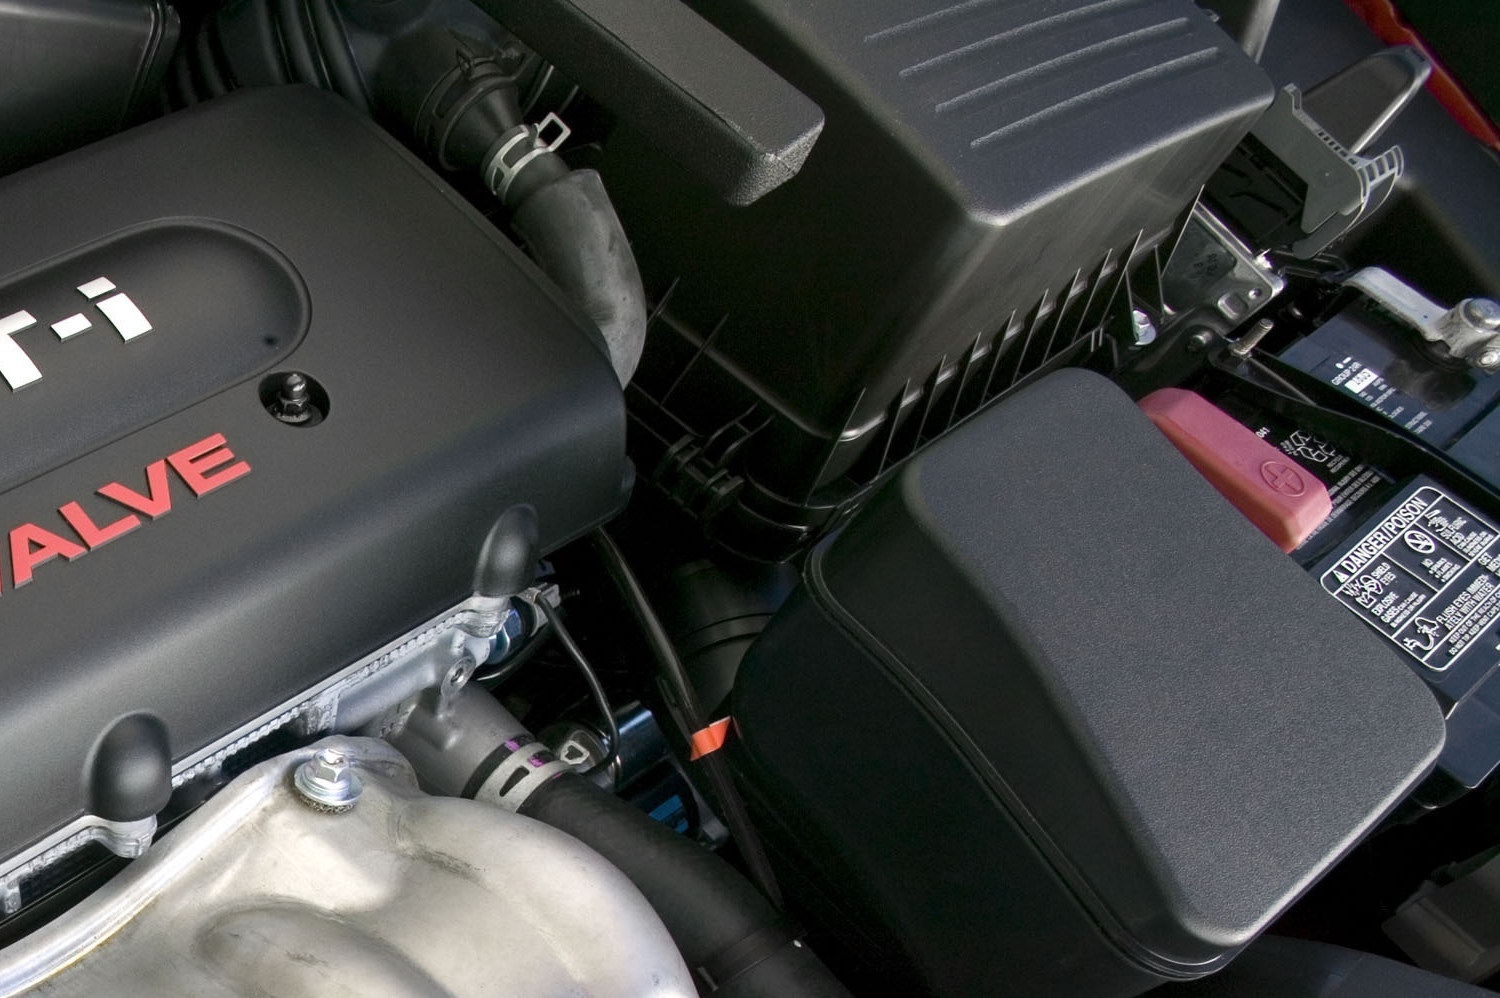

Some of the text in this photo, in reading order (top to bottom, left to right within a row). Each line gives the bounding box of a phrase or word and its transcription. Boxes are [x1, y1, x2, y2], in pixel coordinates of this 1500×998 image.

[1340, 495, 1429, 573] DANGER/POISON
[1370, 561, 1392, 579] SHIELD
[1379, 570, 1397, 586] EYES
[1434, 603, 1459, 625] FLUSH
[1451, 590, 1472, 608] EYES
[1442, 610, 1465, 631] ATELY
[1458, 597, 1478, 615] WITH
[1471, 581, 1495, 602] WATER
